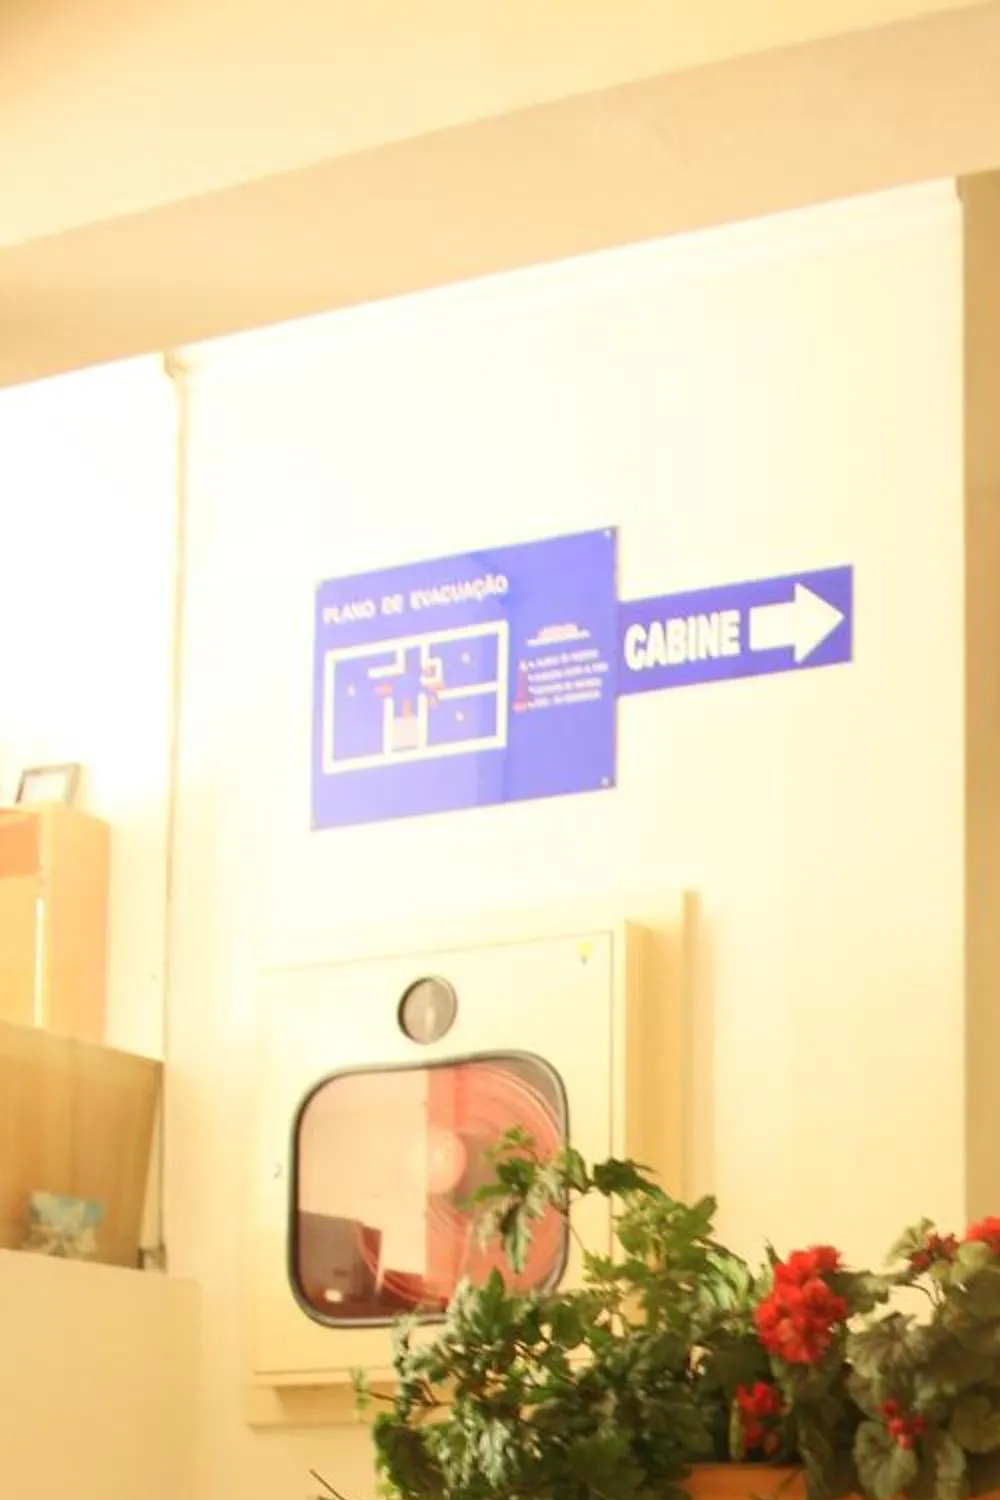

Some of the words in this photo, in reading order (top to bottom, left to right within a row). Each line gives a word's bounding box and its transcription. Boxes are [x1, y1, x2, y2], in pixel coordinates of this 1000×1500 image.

[322, 599, 376, 624] PLANO
[381, 594, 404, 615] DE
[410, 573, 509, 610] EVACUAÇÃO
[624, 610, 741, 671] CABINE
